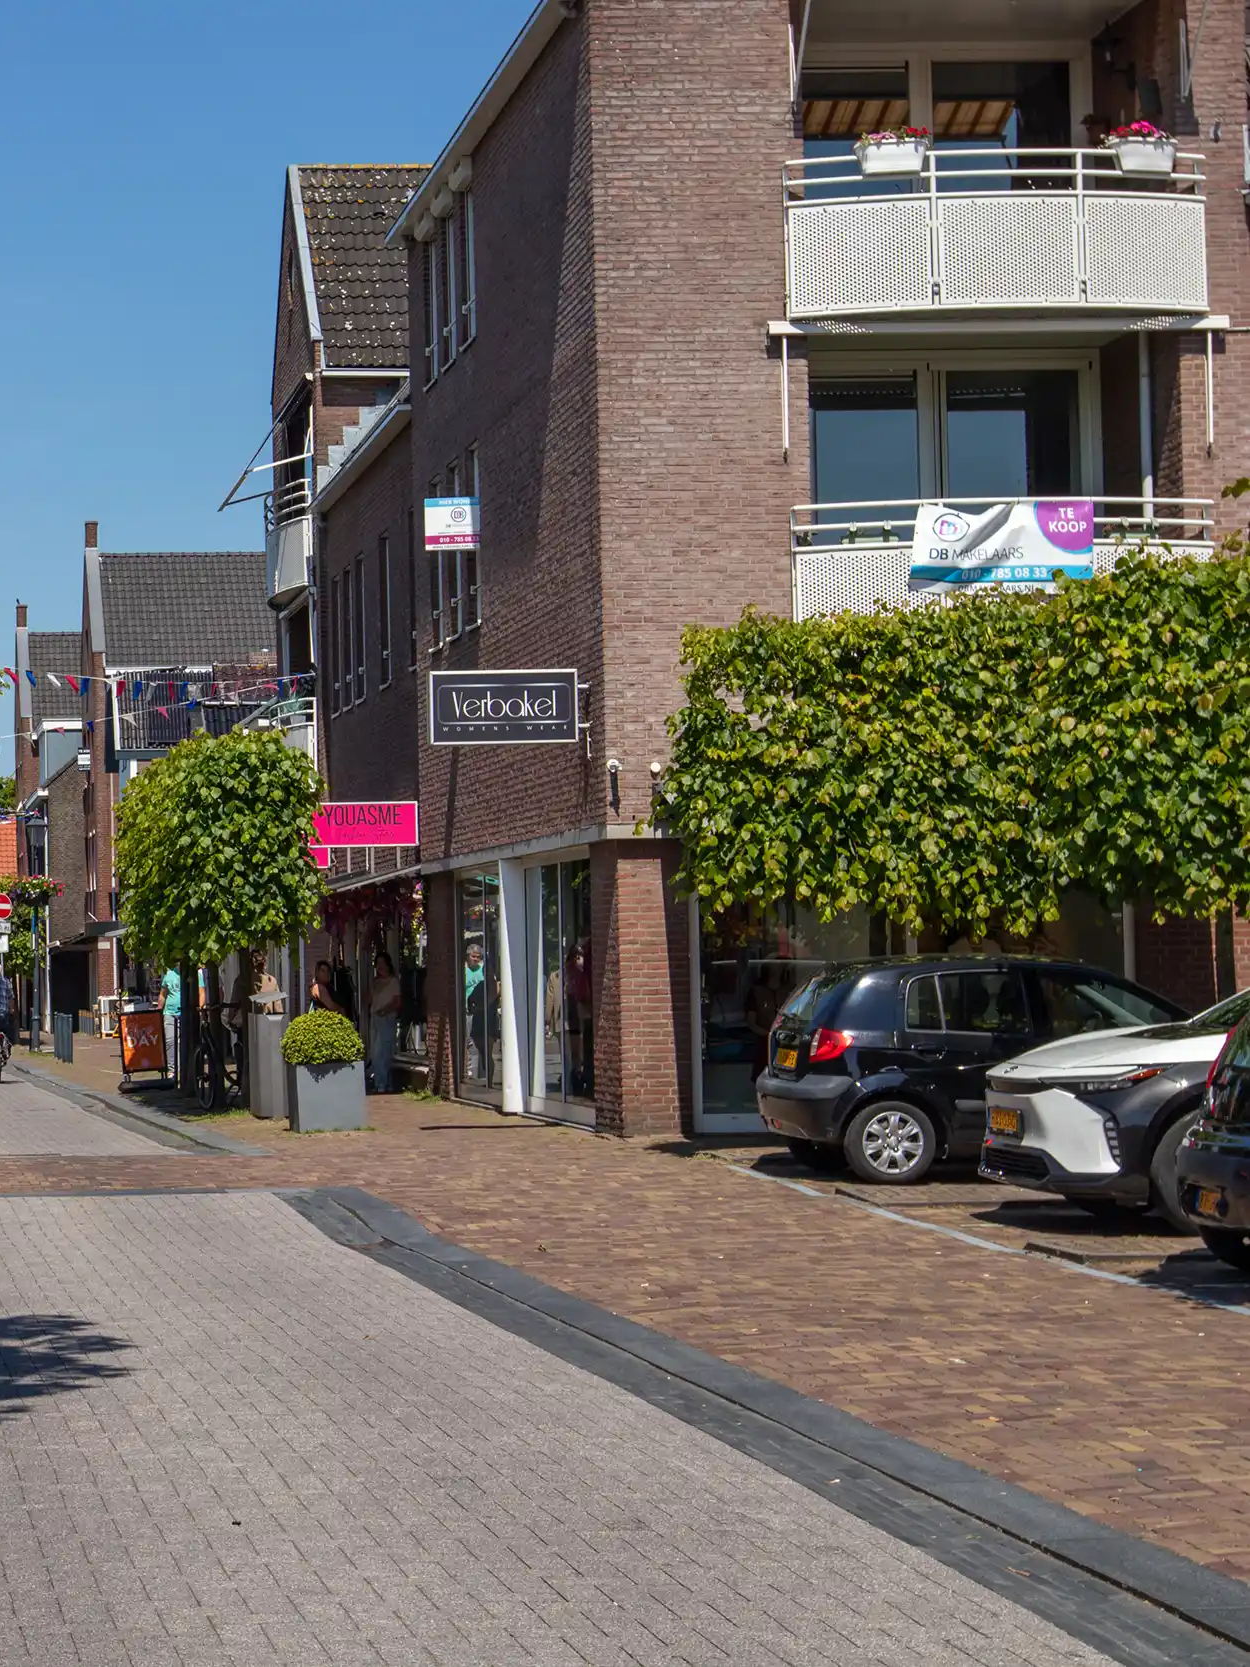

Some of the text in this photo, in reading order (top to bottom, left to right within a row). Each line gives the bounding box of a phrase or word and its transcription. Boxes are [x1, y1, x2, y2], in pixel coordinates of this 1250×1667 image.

[1058, 507, 1075, 519] TE
[1048, 520, 1088, 533] KOOP
[929, 548, 949, 560] DB
[991, 568, 1012, 579] 785
[1015, 568, 1030, 578] 08
[1033, 567, 1048, 578] 33
[452, 690, 556, 719] Verbakel
[323, 804, 403, 827] YOUASME
[127, 1033, 158, 1048] DAY
